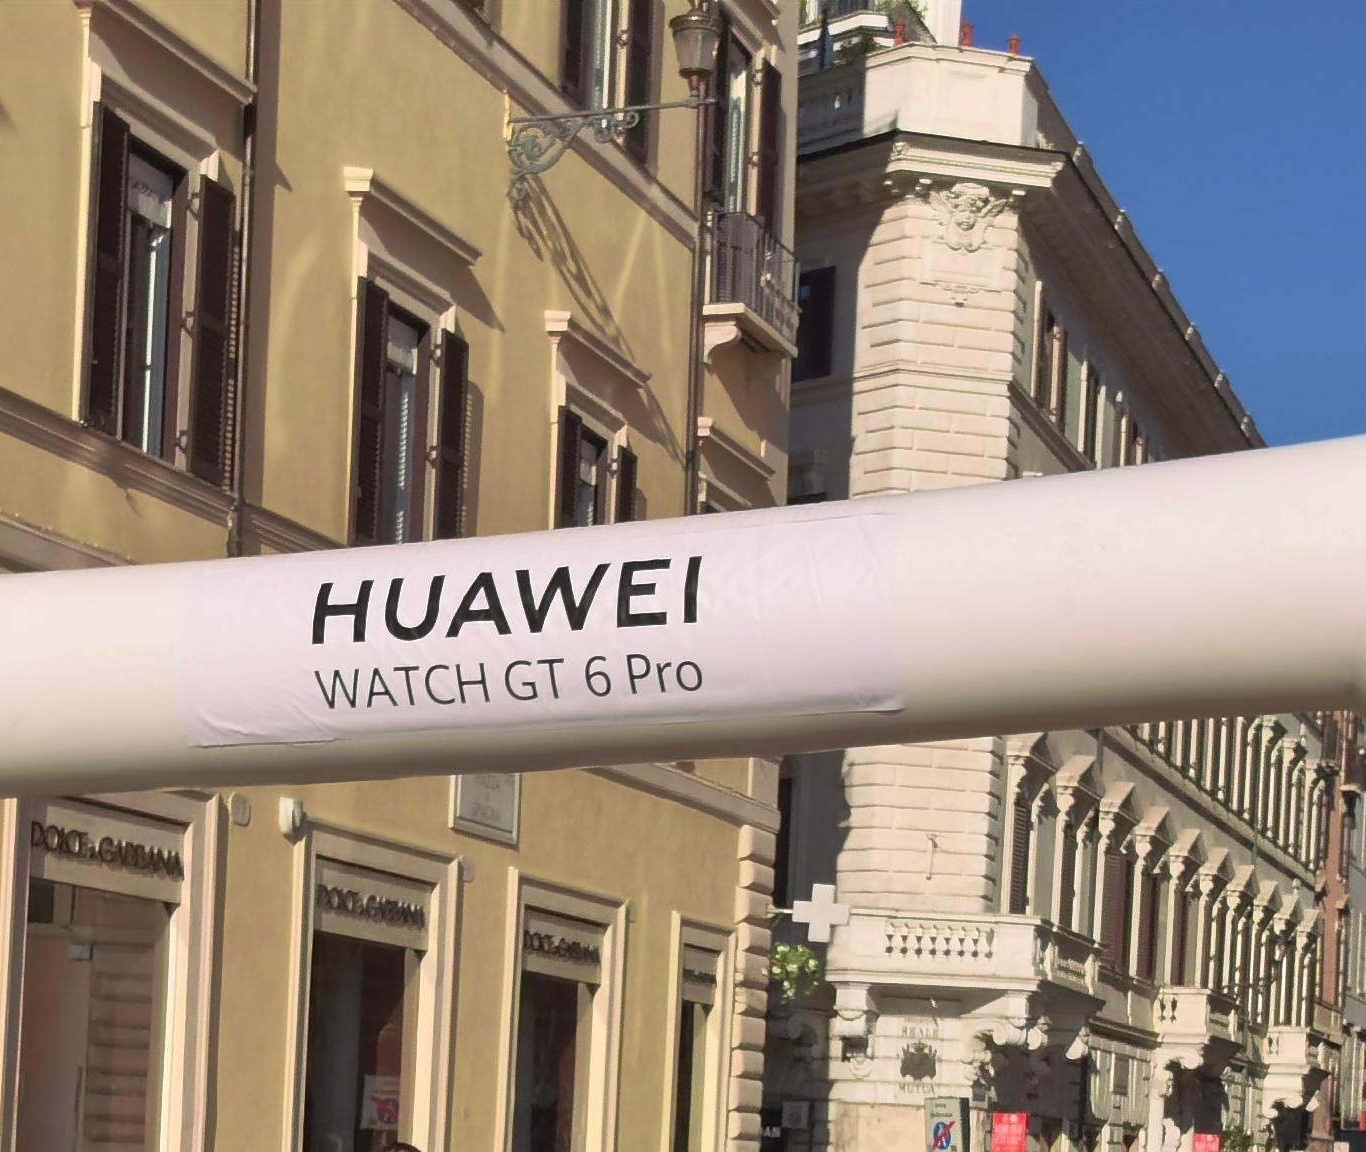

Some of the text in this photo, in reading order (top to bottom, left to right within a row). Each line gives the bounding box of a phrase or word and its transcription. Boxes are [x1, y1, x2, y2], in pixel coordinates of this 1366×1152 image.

[310, 555, 703, 645] HUAWEI
[314, 652, 703, 710] WATCH GT 6 Pro
[30, 820, 88, 858] DOLCE
[98, 835, 185, 882] GABBANA
